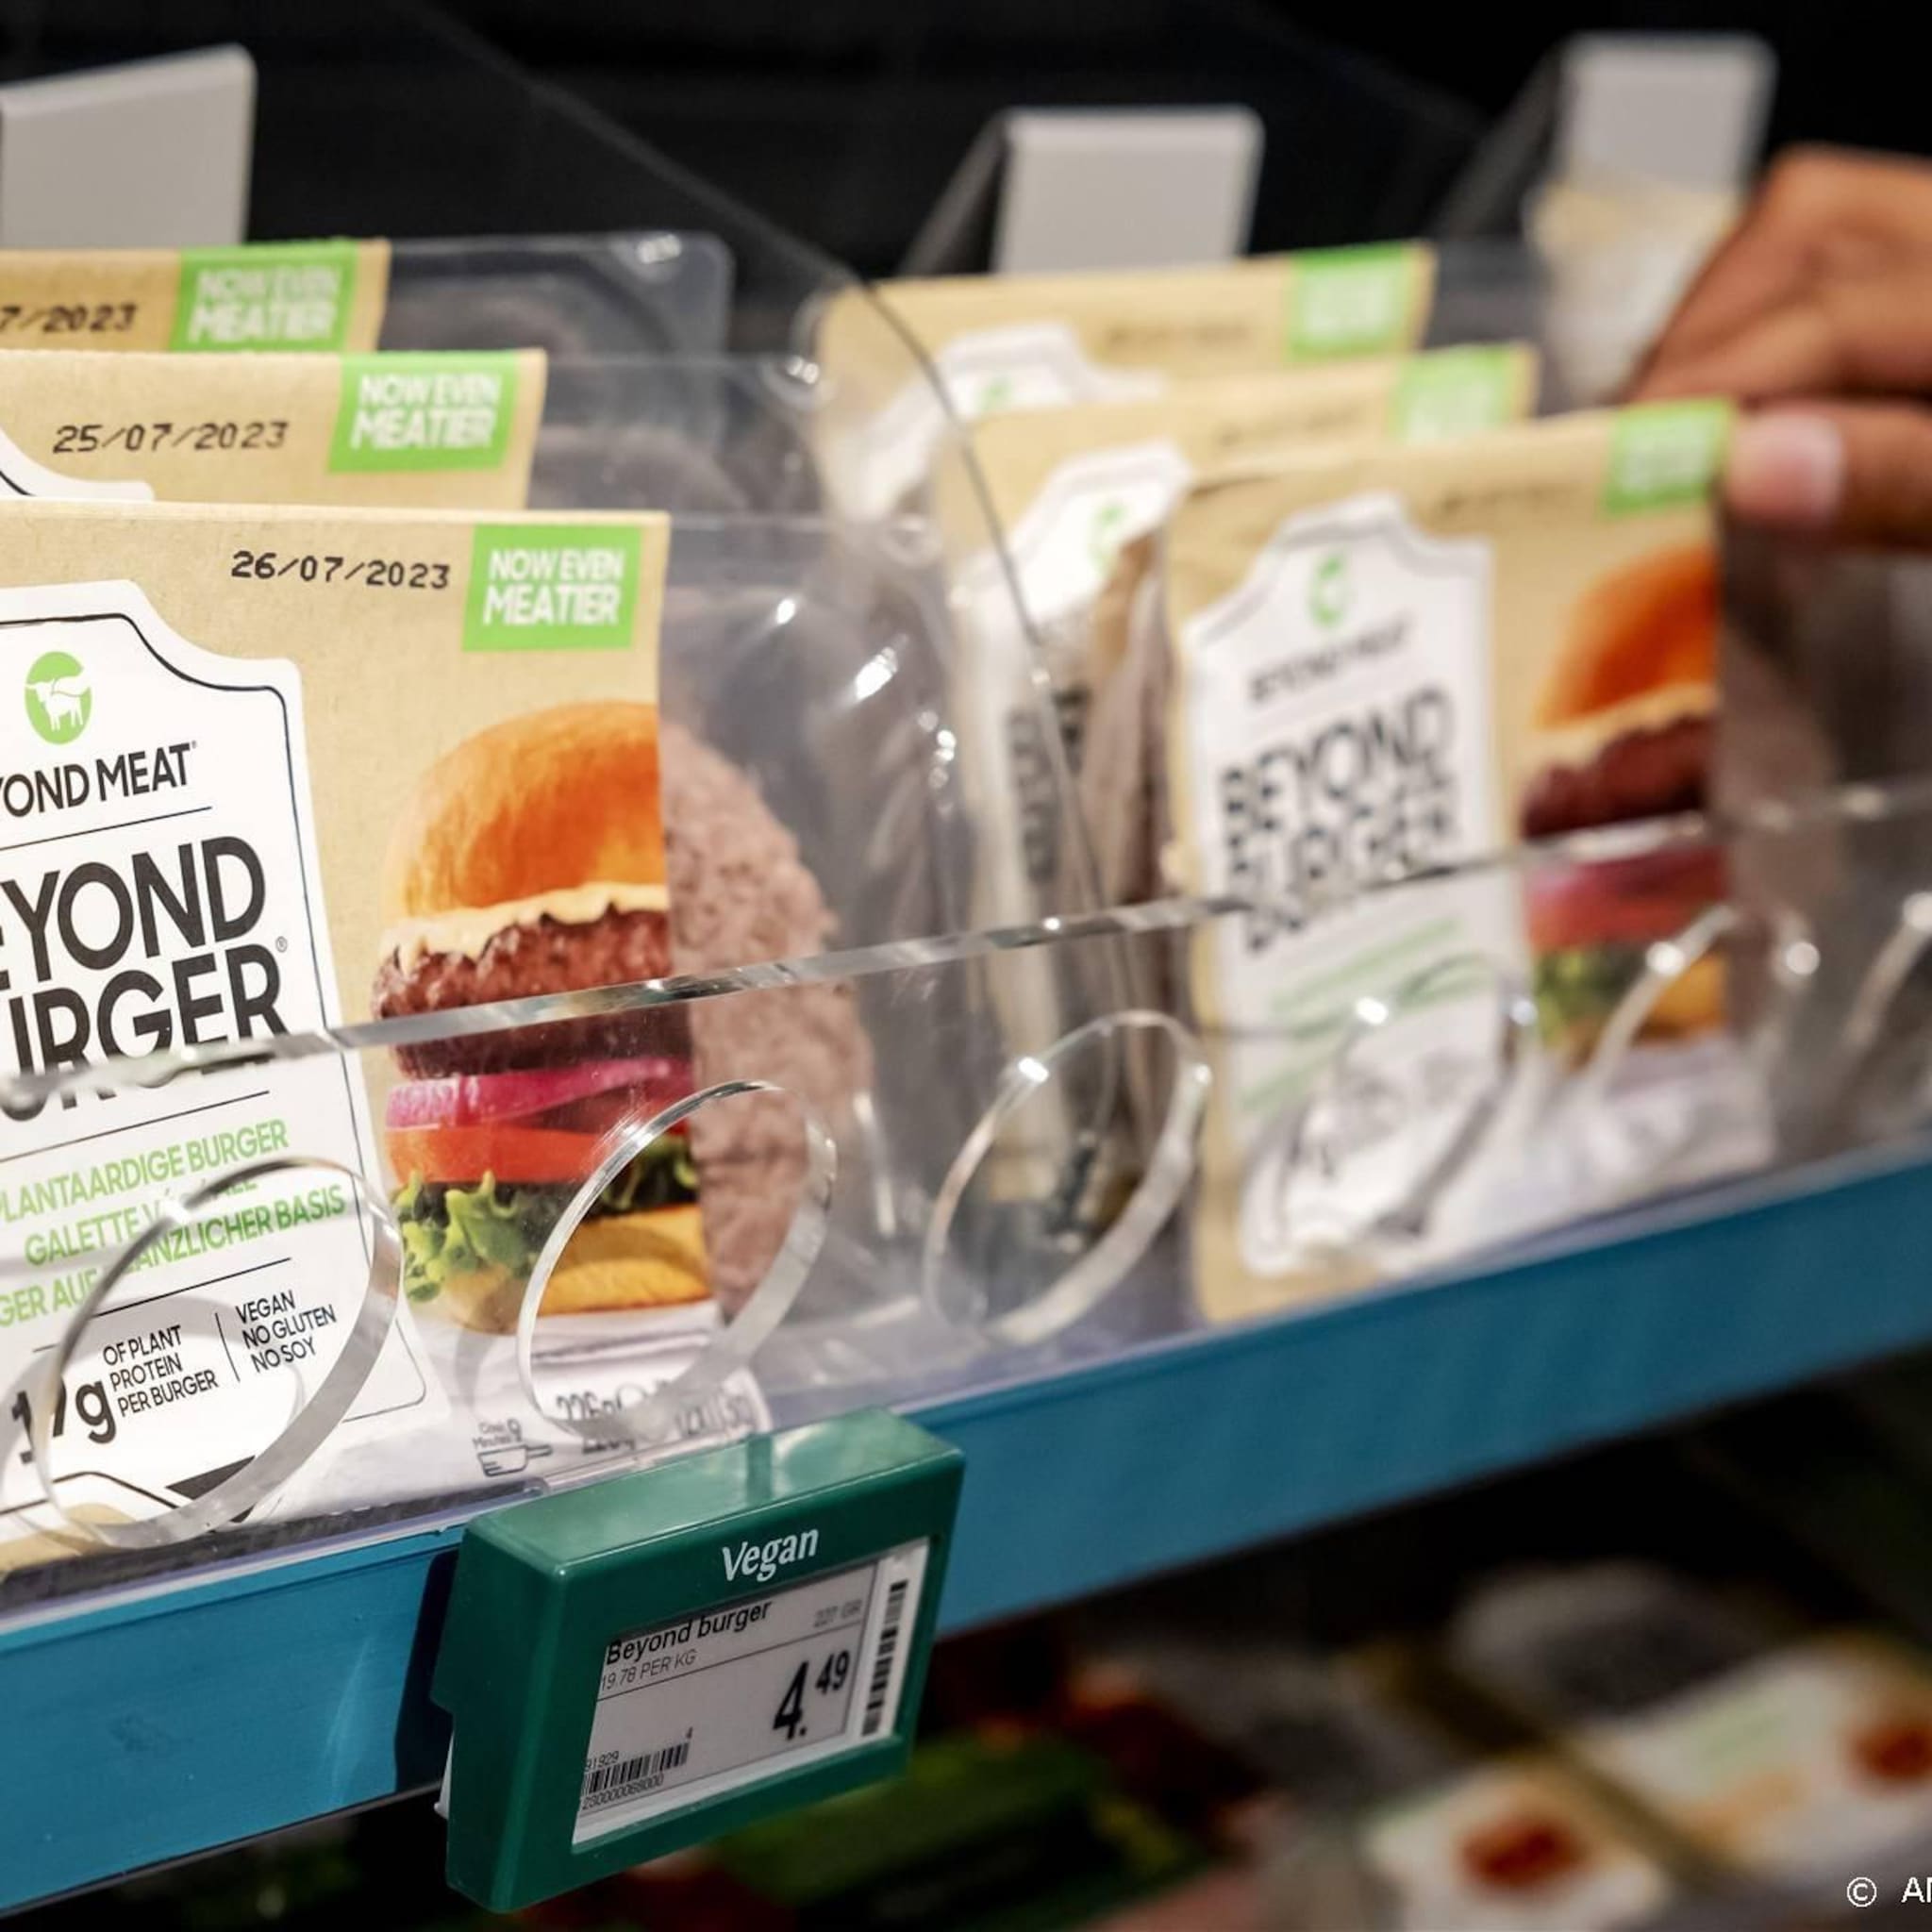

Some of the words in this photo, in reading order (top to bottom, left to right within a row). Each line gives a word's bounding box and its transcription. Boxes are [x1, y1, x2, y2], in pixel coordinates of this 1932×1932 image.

[187, 300, 339, 344] MEATIER
[360, 373, 431, 405] NOW
[433, 372, 502, 405] EVEN
[53, 420, 289, 454] 25/07/2023
[350, 408, 498, 449] MEATIER
[231, 550, 451, 590] 26/07/2023
[489, 549, 558, 581] NOW
[559, 548, 625, 581] EVEN
[482, 583, 623, 626] MEATIER
[0, 764, 90, 818] OND
[95, 741, 192, 802] MEAT
[0, 835, 266, 990] YOND
[0, 1144, 185, 1224] LANTAARDIGE
[186, 1119, 290, 1173] BURGER
[273, 1184, 347, 1231] BASIS
[25, 1207, 142, 1267] GALETTE
[236, 1291, 296, 1324] VEGAN
[242, 1324, 271, 1350] NO
[272, 1304, 338, 1340] GLUTEN
[103, 1340, 127, 1366] OF
[129, 1324, 183, 1359] PLANT
[251, 1348, 281, 1374] NO
[279, 1336, 317, 1364] SOY
[109, 1353, 183, 1392] PROTEIN
[118, 1391, 152, 1418] PER
[152, 1368, 219, 1407] BURGER
[722, 1528, 819, 1582] Vegan
[607, 1618, 693, 1663] Beyond
[696, 1601, 773, 1640] burger
[640, 1656, 674, 1680] PER
[674, 1649, 698, 1669] KG
[815, 1650, 850, 1695] 49
